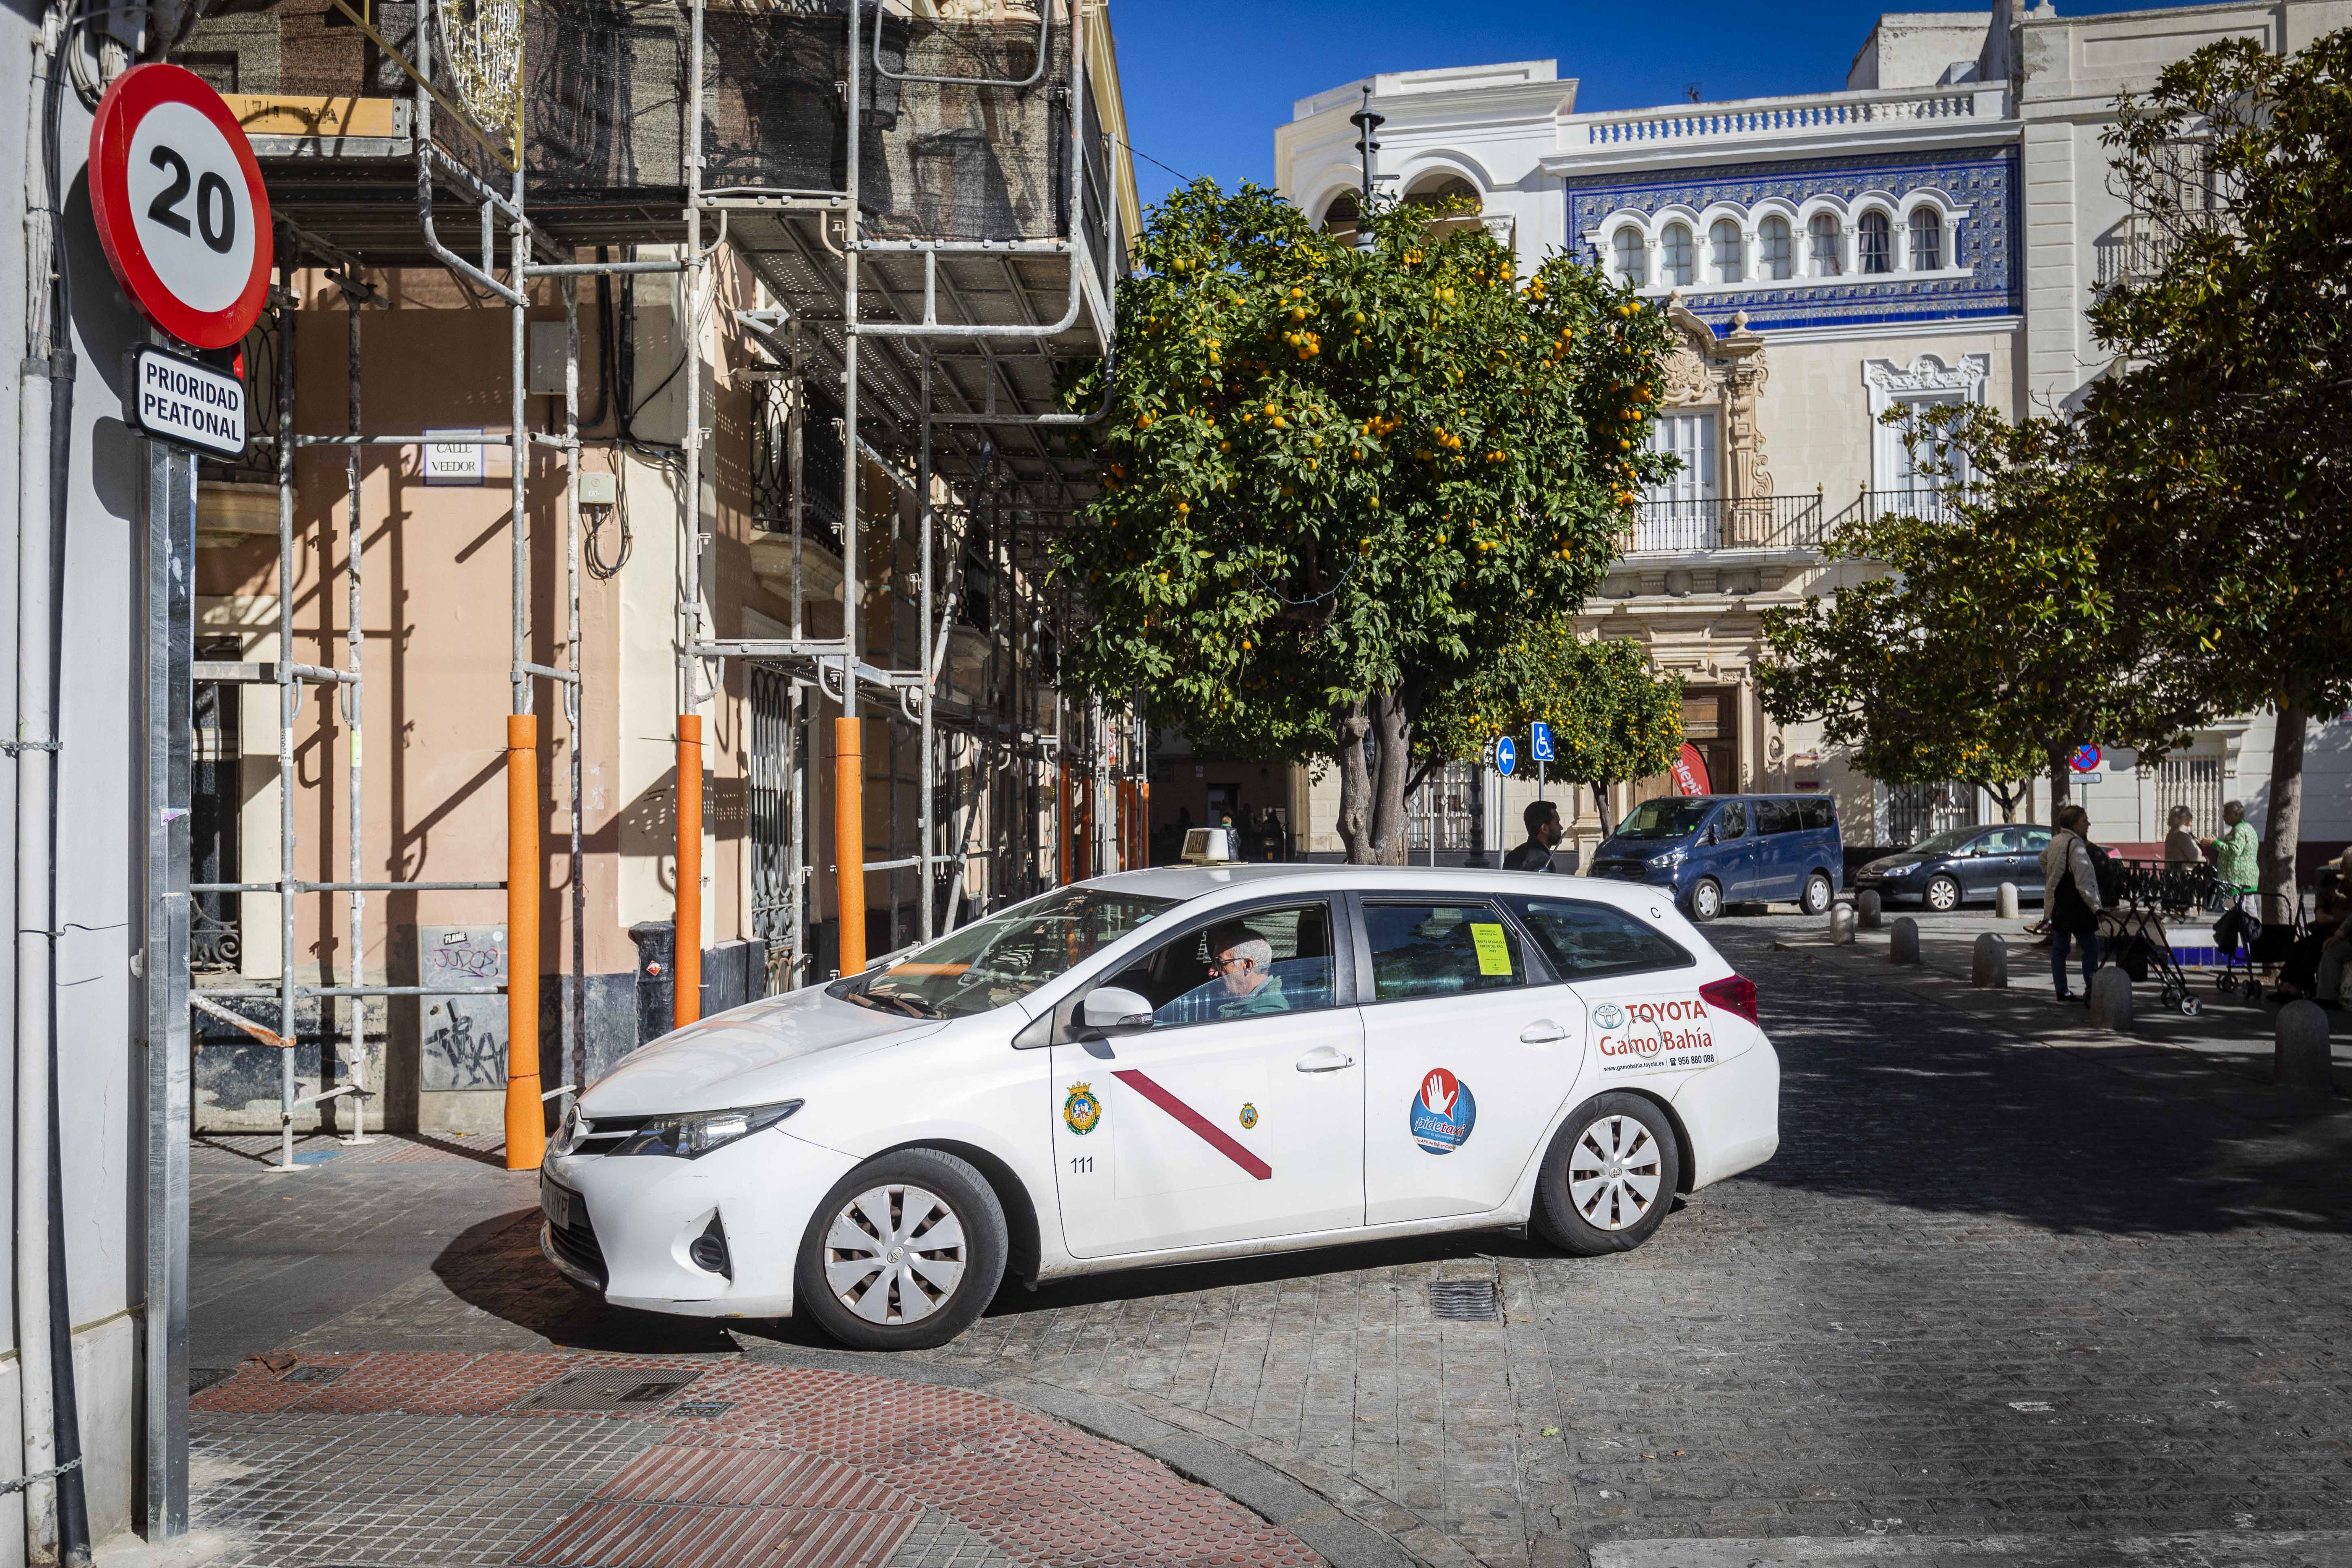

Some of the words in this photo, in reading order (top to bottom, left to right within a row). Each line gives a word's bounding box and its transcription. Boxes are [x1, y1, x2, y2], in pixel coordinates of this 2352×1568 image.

[147, 145, 235, 254] 20
[147, 362, 238, 412] PRIORIDAD
[144, 394, 241, 442] PEATONAL
[437, 444, 472, 453] CALLE
[432, 462, 476, 472] VEEDOR
[1188, 833, 1204, 852] TAXI
[1650, 907, 1661, 918] C
[445, 932, 466, 944] FLAME
[1625, 1001, 1707, 1024] TOYOTA
[1601, 1035, 1657, 1056] Gamo
[1663, 1027, 1712, 1050] Bahía
[1604, 1061, 1664, 1072] www.gamobahia.toyota.es
[1678, 1056, 1689, 1065] 956
[1691, 1055, 1702, 1064] 880
[1703, 1054, 1714, 1063] 088
[1414, 1116, 1466, 1137] pidetaxi
[1071, 1156, 1093, 1173] 111
